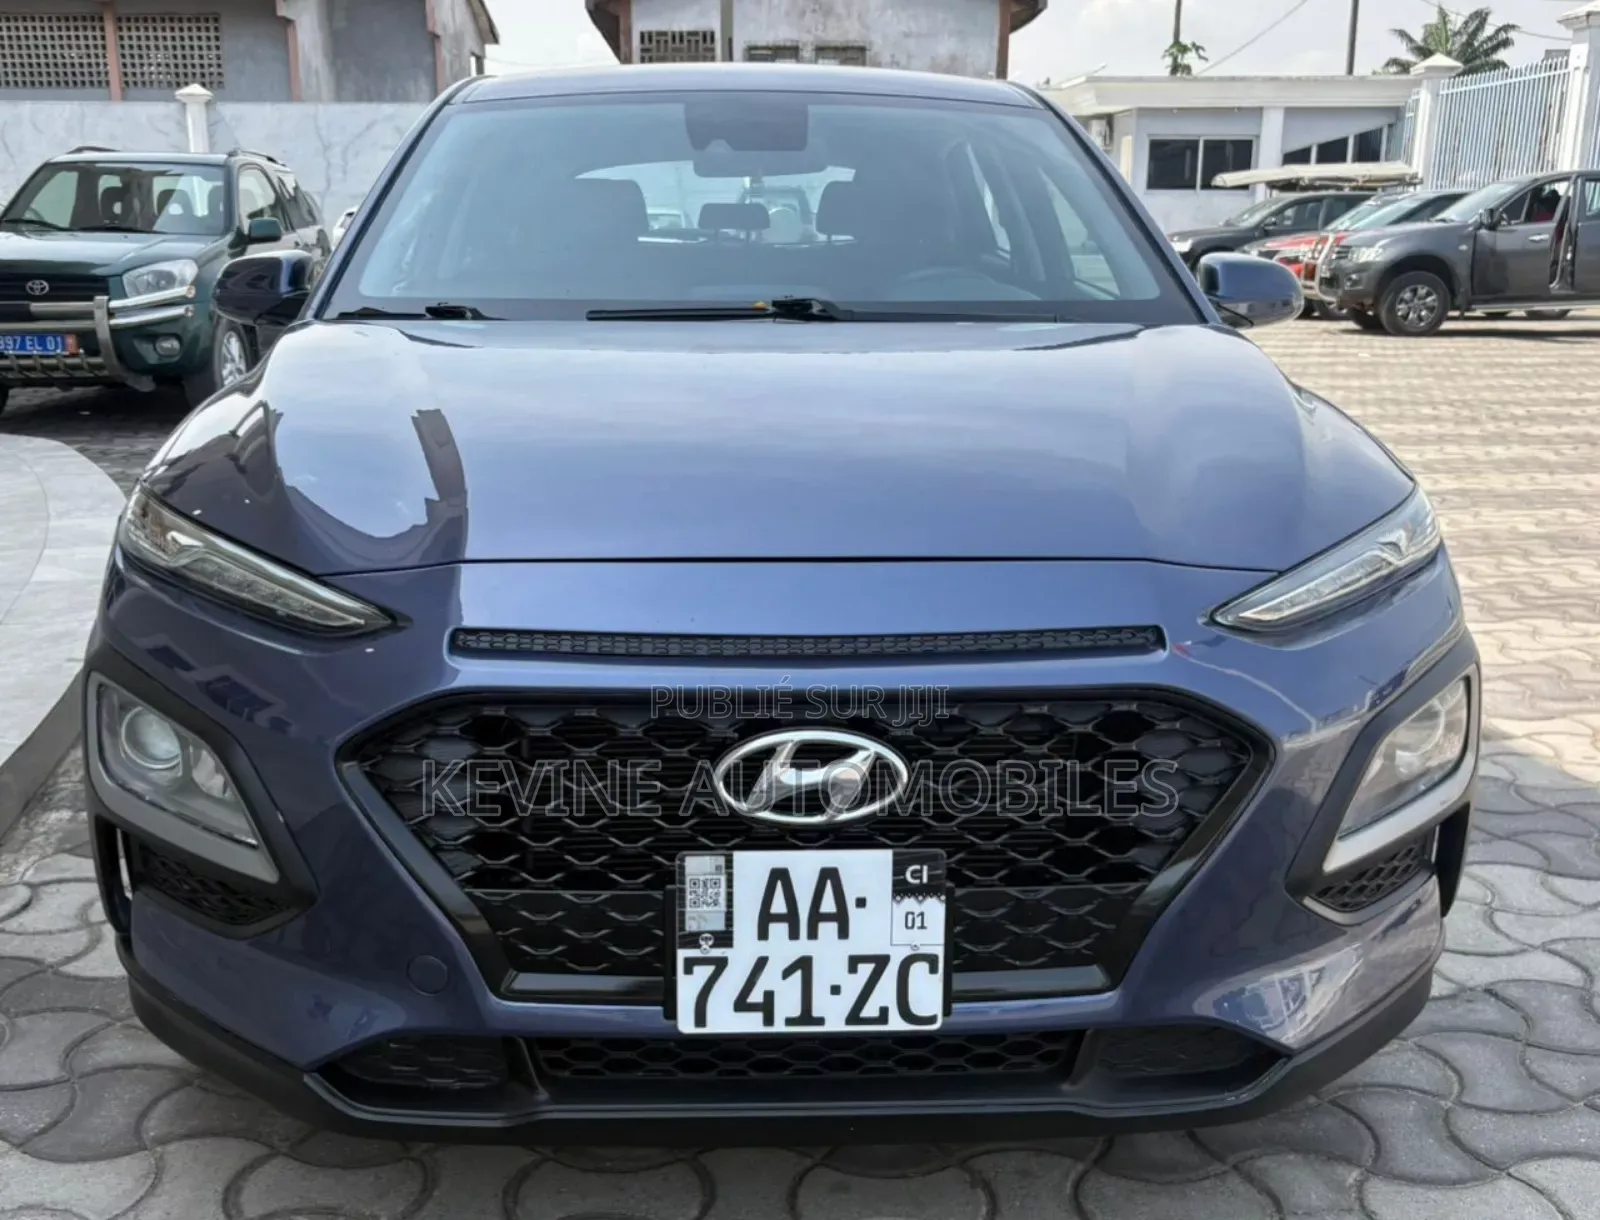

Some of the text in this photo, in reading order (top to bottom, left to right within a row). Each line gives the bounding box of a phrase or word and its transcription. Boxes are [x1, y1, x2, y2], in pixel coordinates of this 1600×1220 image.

[26, 336, 42, 350] EL
[45, 335, 62, 349] 01
[905, 864, 929, 884] CI
[904, 910, 928, 930] 01
